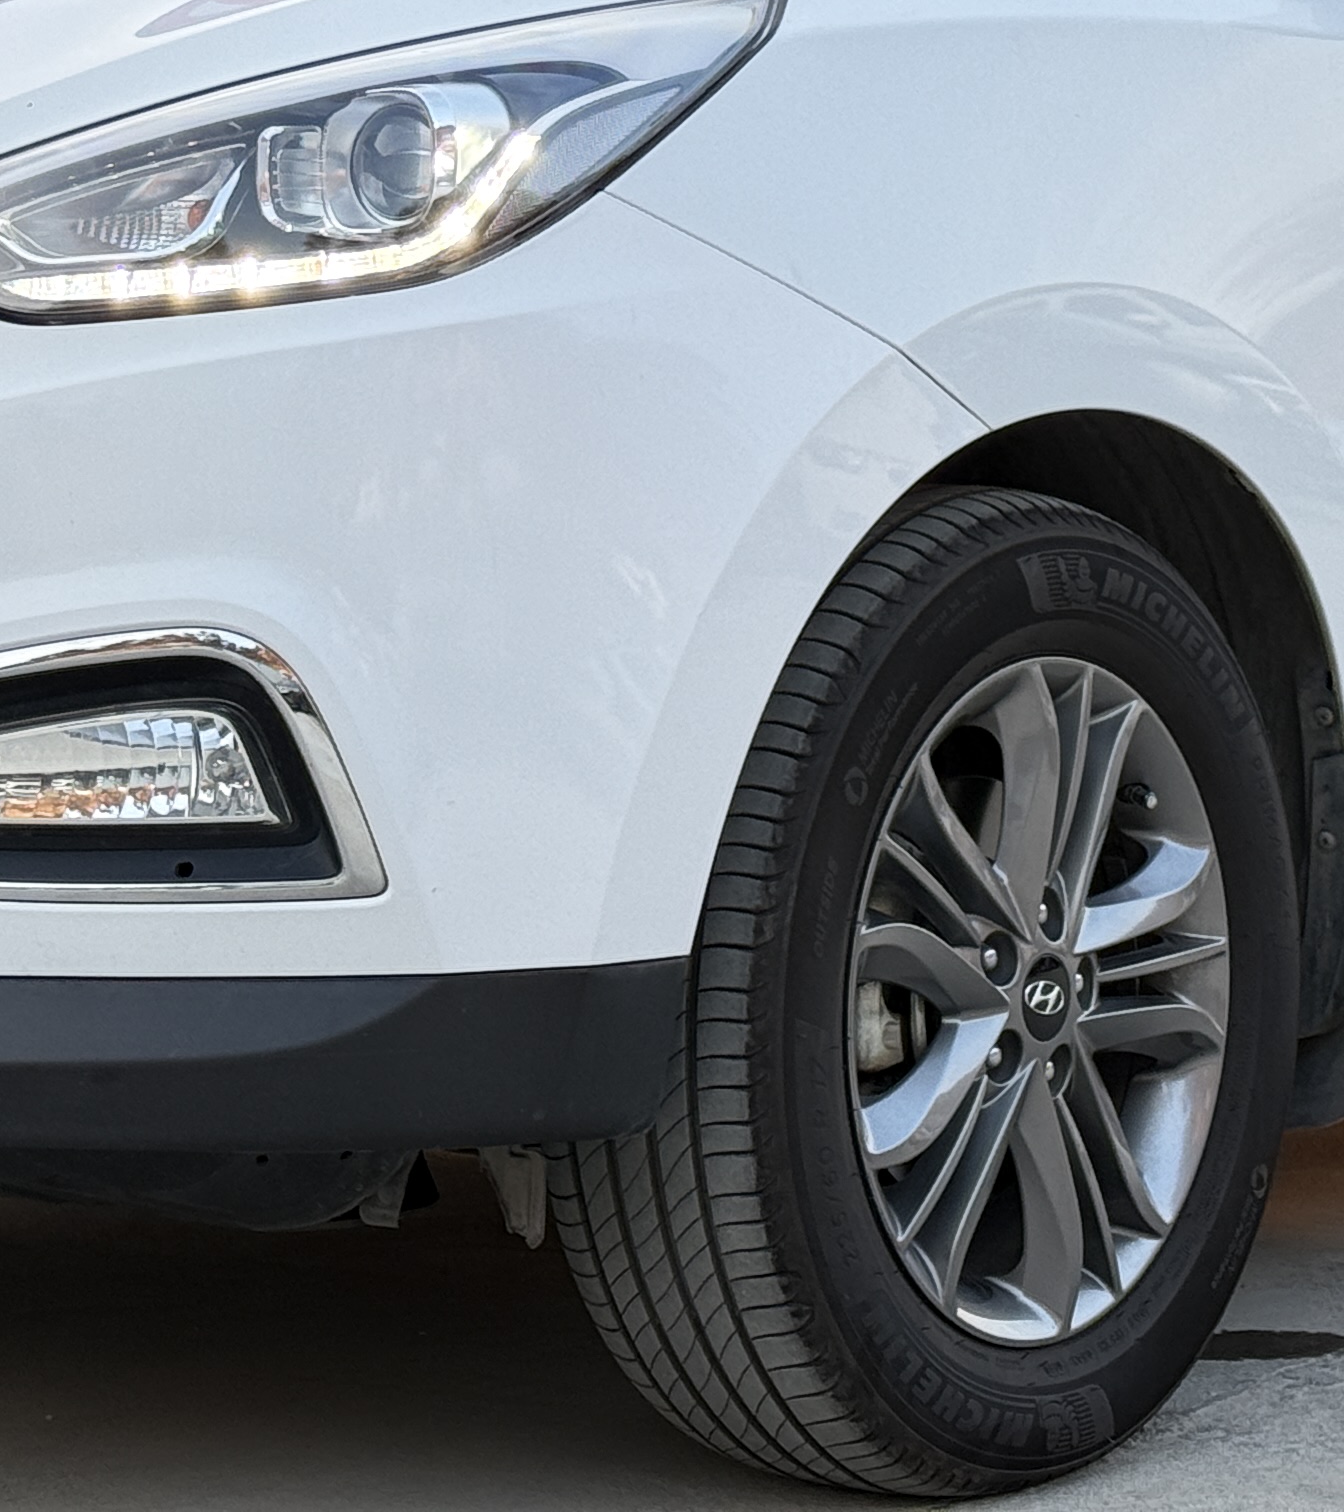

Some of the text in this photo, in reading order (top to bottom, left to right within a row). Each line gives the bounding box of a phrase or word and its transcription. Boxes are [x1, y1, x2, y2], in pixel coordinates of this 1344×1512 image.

[1100, 567, 1248, 723] MICHELIN
[812, 852, 839, 959] OUTSIDE
[860, 1301, 1037, 1448] MICHELIN
